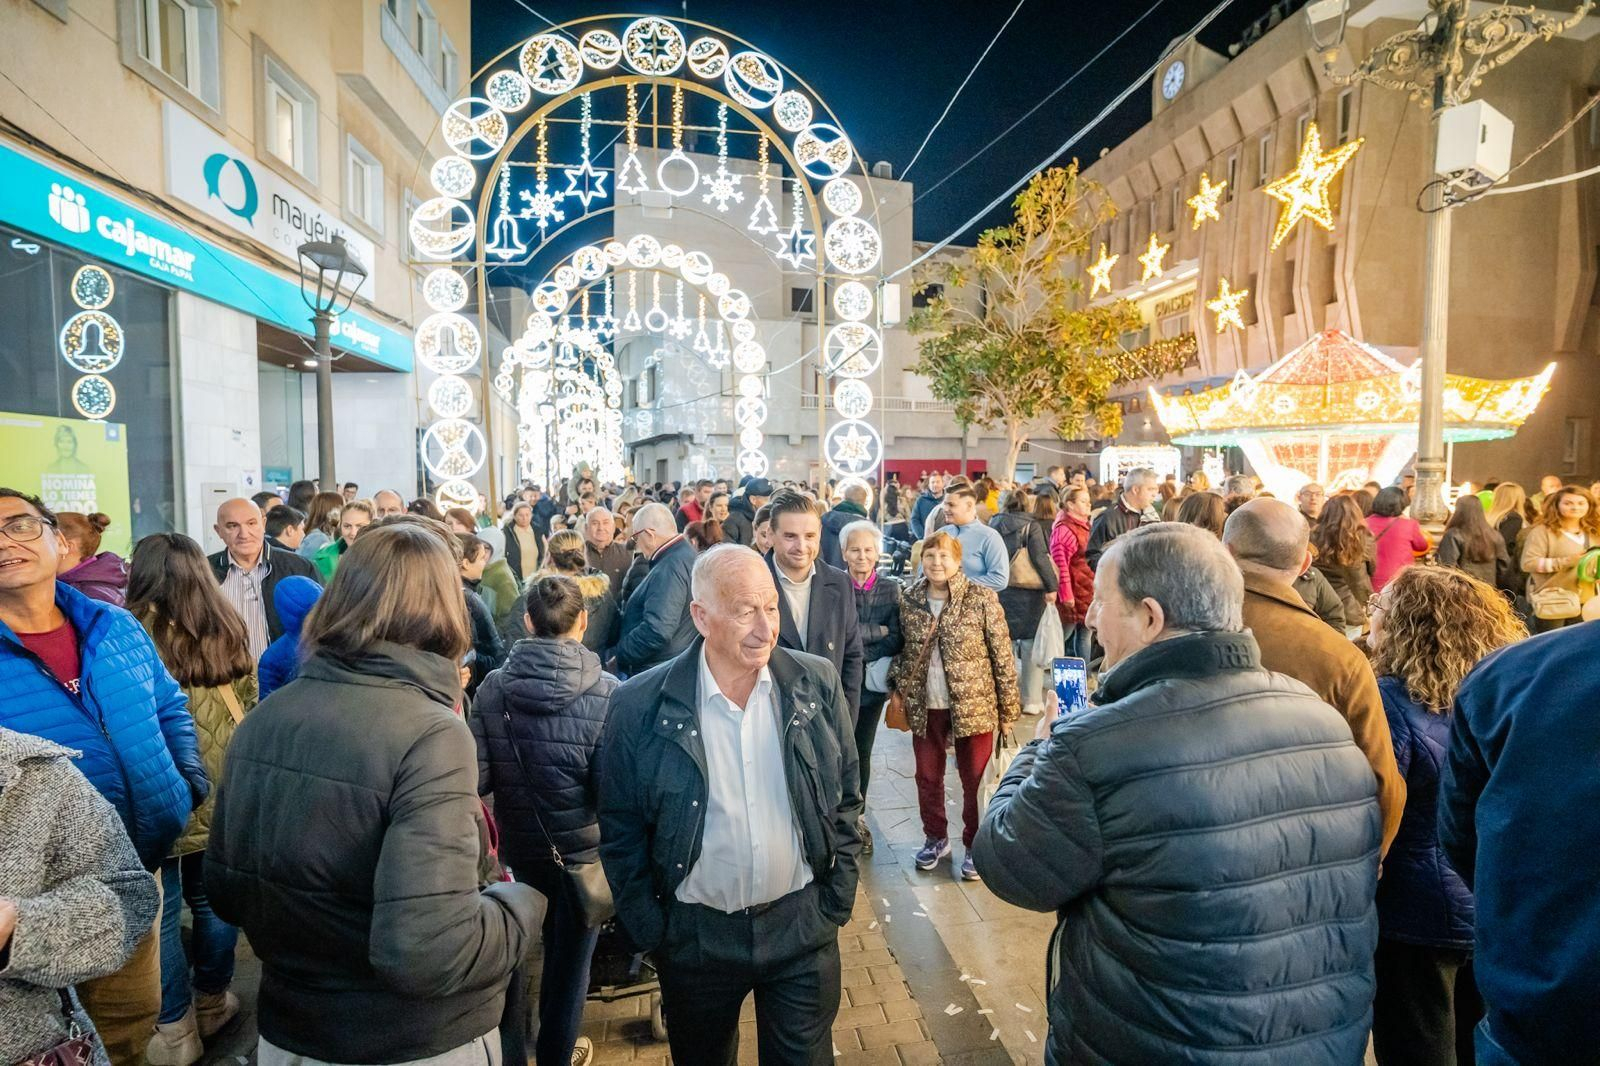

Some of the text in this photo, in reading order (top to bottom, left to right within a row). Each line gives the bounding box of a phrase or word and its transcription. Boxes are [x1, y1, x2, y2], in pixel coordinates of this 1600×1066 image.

[272, 193, 356, 249] mayéu
[96, 215, 196, 272] cajamar
[149, 257, 171, 273] CAJA
[341, 320, 381, 349] cajamar
